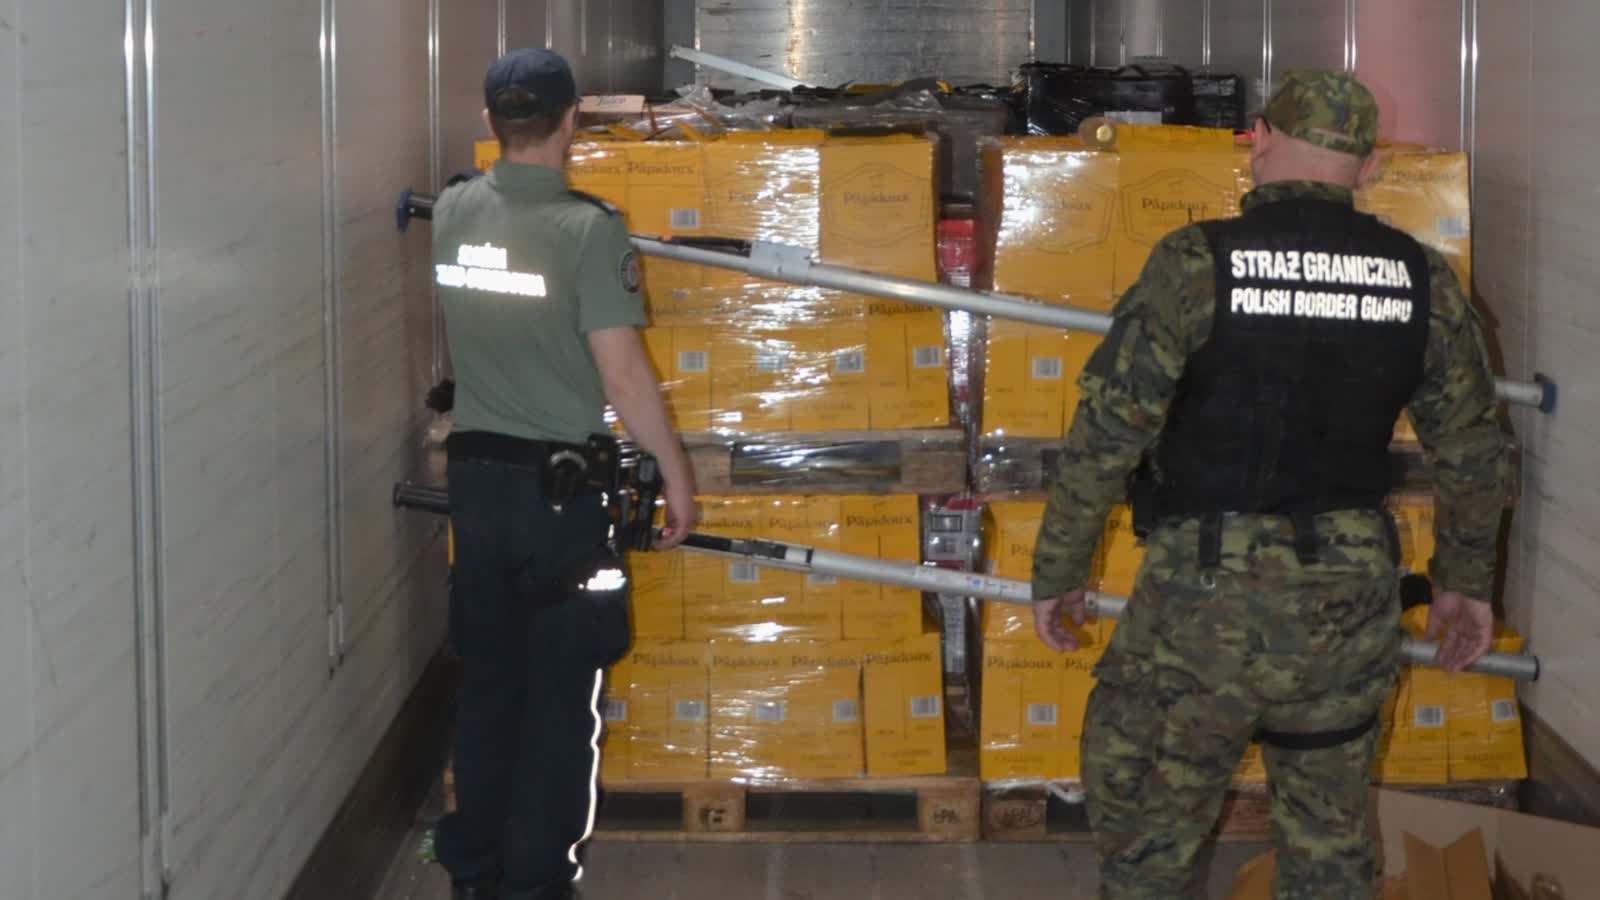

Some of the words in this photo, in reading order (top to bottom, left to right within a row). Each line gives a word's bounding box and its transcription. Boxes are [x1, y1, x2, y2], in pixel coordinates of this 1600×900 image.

[1230, 249, 1301, 281] STRAŻ
[1302, 252, 1412, 289] GRANICZNA
[1230, 287, 1292, 316] POLISH
[1293, 290, 1358, 321] BORDER
[1360, 295, 1413, 324] GUARD
